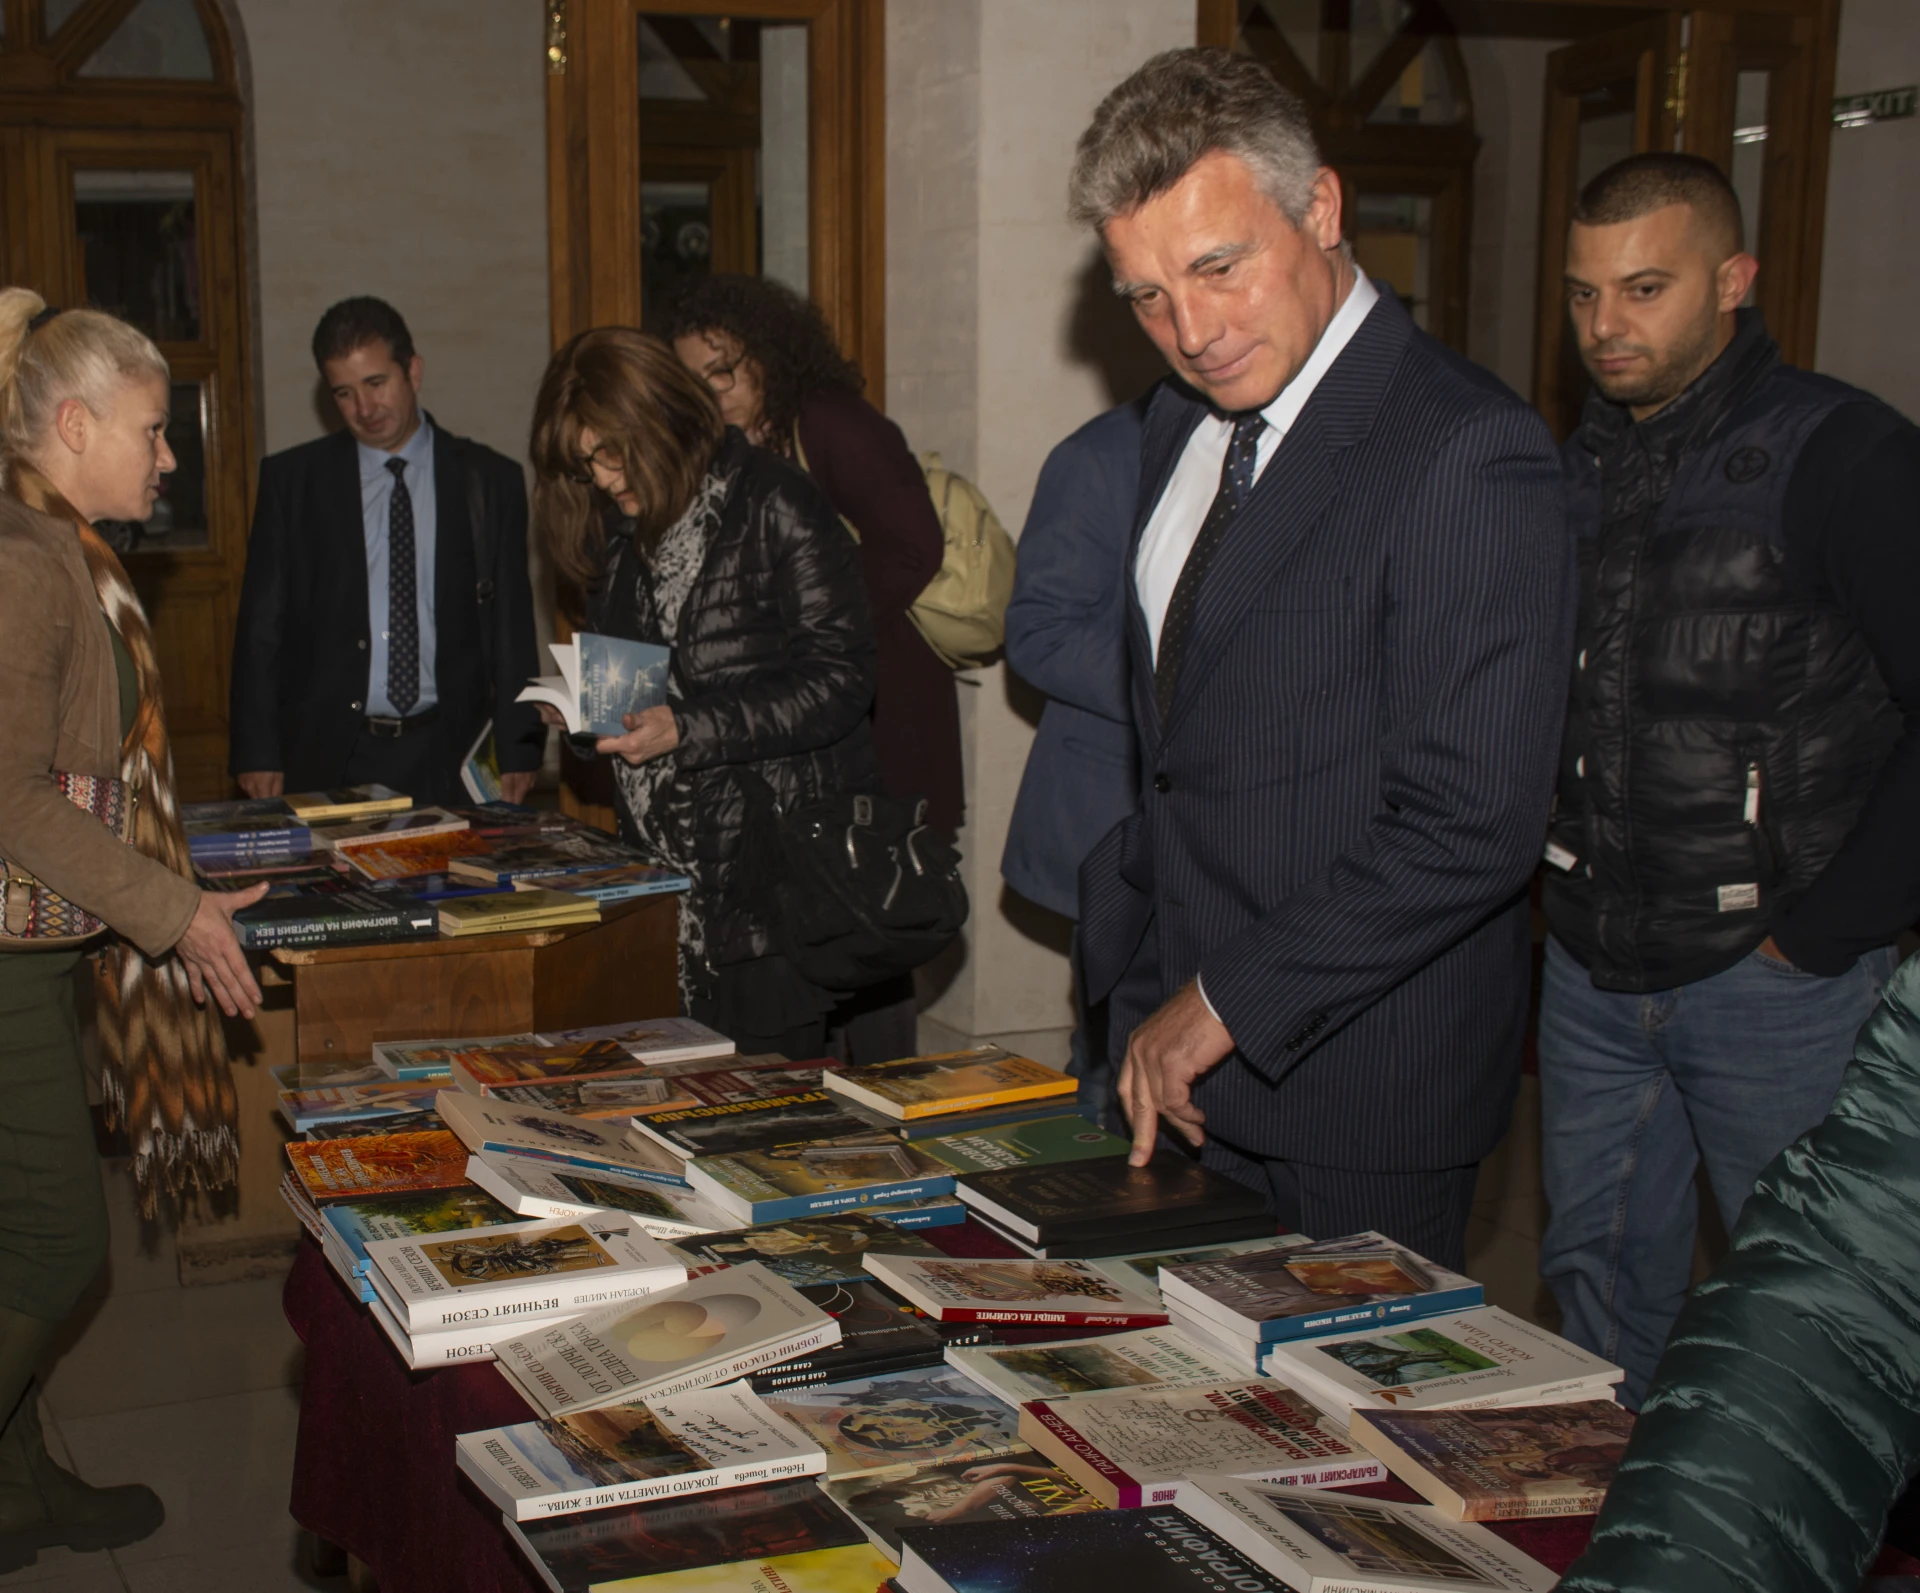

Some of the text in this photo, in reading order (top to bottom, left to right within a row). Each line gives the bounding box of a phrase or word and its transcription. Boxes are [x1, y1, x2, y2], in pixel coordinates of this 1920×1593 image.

[1851, 93, 1911, 115] EXIT
[255, 916, 398, 938] БИОГРАФИЯ НА МЪРТВИЯ ВЕК
[963, 1136, 1028, 1166] РАЗКАЗИ
[574, 1286, 651, 1304] ЙОРДАН МИЛЕВ
[441, 1297, 559, 1325] ВЕЧНИЯТ СЕЗОН
[1020, 1313, 1032, 1321] НА
[1033, 1312, 1066, 1322] ТАНЦЪТ
[1304, 1310, 1372, 1328] ЖЕЛЕЗНИ ИКОНИ
[445, 1343, 492, 1359] СЕЗОН
[567, 1321, 639, 1387] ГЛЕДНА ТОЧКА
[778, 1333, 823, 1357] ДОБРИН
[1142, 1334, 1221, 1378] НА ПОЕТИТЕ
[1489, 1335, 1535, 1361] КОЕТО
[543, 1328, 613, 1395] ОТ ЛОГИЧЕСКА
[731, 1348, 777, 1372] СПАСОВ
[793, 1362, 812, 1370] СЛАВ
[1116, 1346, 1169, 1375] ТАЙНАТА
[508, 1341, 577, 1407] ДОБРИН СПАСОВ
[649, 1370, 712, 1398] ЛОГИЧЕСКА
[713, 1367, 728, 1378] ОТ
[772, 1371, 826, 1385] СЛАВ БАКАЛОВ
[1468, 1367, 1515, 1384] Христо
[1203, 1389, 1232, 1409] УМ.
[1038, 1412, 1079, 1446] АНЧЕВ
[1224, 1388, 1332, 1458] НЕПРОЧЕТЕНИЯТ
[1245, 1384, 1353, 1454] ЦВЕТАН СТОЯНОВ
[1223, 1406, 1311, 1460] БЪЛГАРСКИЯТ
[482, 1438, 542, 1490] НЕВЕНА ТОШЕВА
[1076, 1442, 1120, 1475] ПАНКО
[1437, 1438, 1510, 1489] СМИРНЕНСКИ
[673, 1474, 719, 1492] ДОКАТО
[733, 1463, 806, 1482] Невена Тошева
[1300, 1474, 1317, 1484] УМ.
[1318, 1466, 1378, 1482] БЪЛГАРСКИЯТ
[1451, 1460, 1495, 1491] ХРИСТО
[585, 1496, 592, 1507] Е
[595, 1492, 615, 1504] МИ
[618, 1482, 670, 1501] ПАМЕТТА
[1498, 1504, 1597, 1517] ХРИСТО СМИРНЕНСКИ
[1218, 1490, 1313, 1560] ТАНЯ БЛАГОВА
[1144, 1531, 1190, 1563] Янев
[1147, 1515, 1274, 1593] ОГРАФИЯ
[1444, 1527, 1509, 1567] МАСЛИНИ
